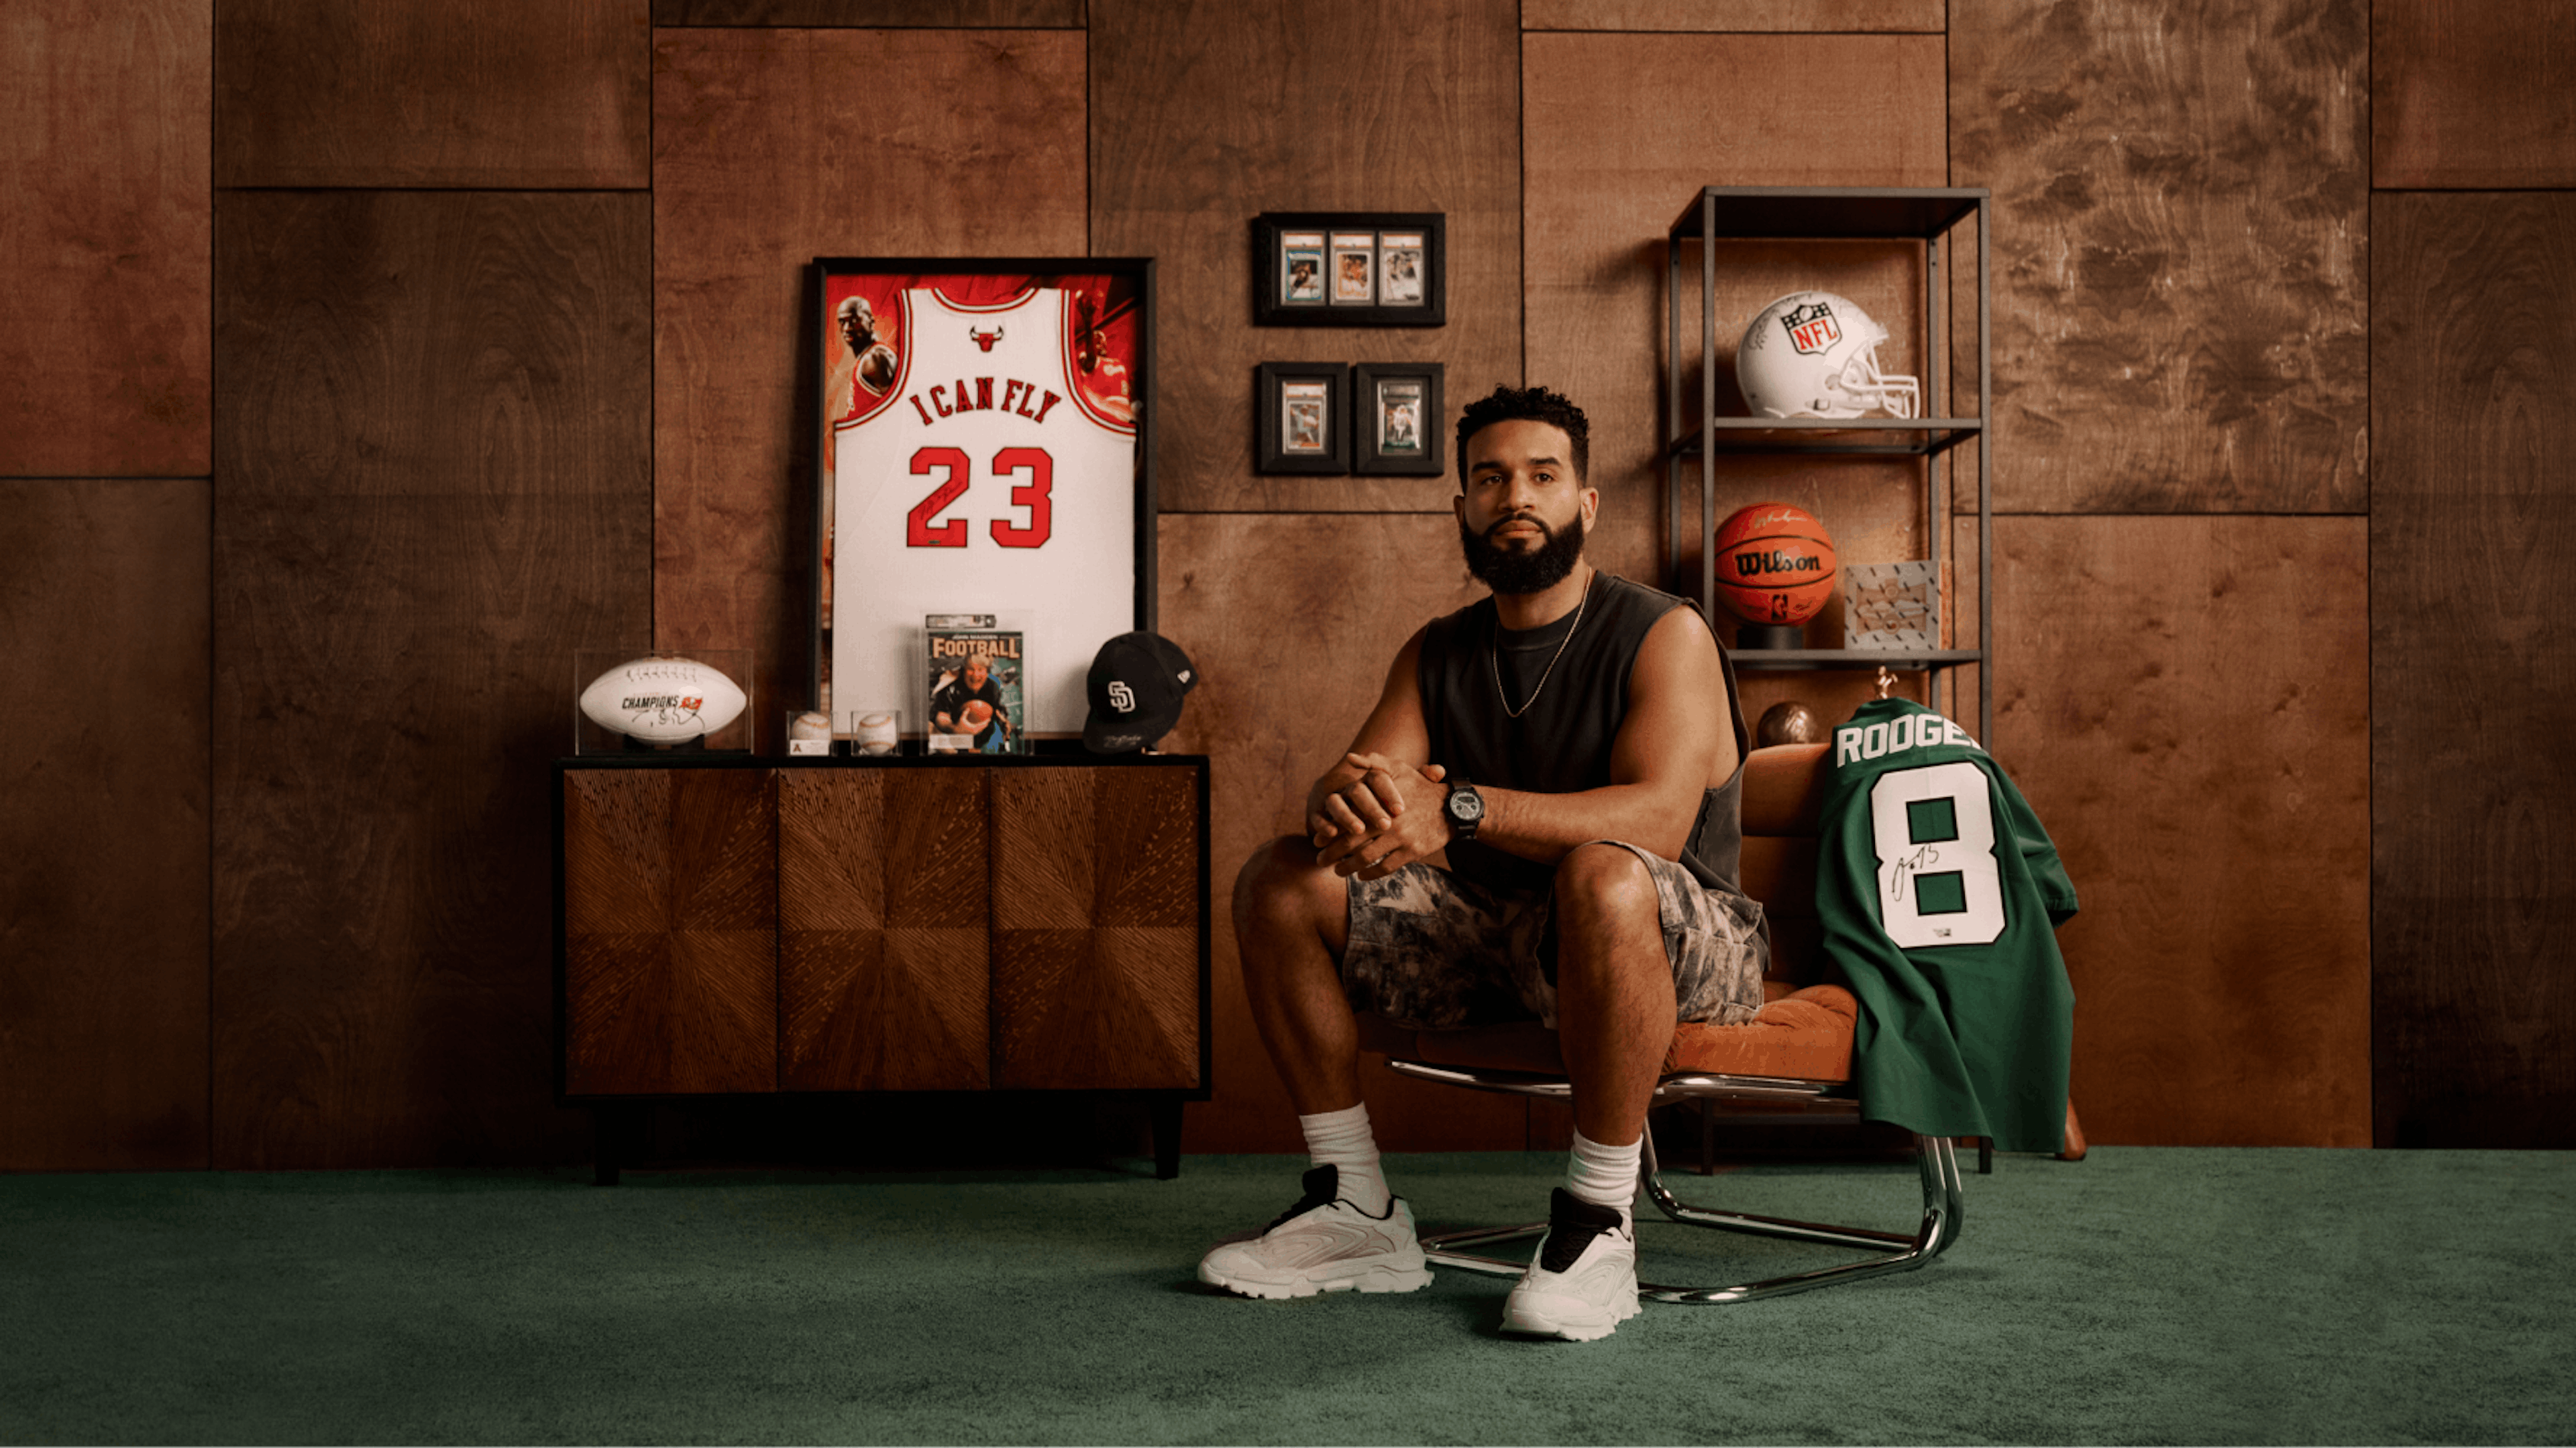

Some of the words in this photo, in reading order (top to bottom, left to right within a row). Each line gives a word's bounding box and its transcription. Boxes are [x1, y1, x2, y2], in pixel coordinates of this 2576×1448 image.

[1792, 319, 1839, 350] NFL
[910, 394, 933, 426] I
[930, 377, 994, 417] CAN
[1001, 378, 1061, 424] FLY
[907, 447, 1053, 548] 23
[1735, 550, 1821, 576] Wilson
[932, 637, 1020, 658] FOOTBALL
[622, 695, 679, 709] CHAMPIONS
[1108, 680, 1136, 713] SD
[1837, 713, 1988, 768] RODGE
[1871, 761, 2005, 948] 8
